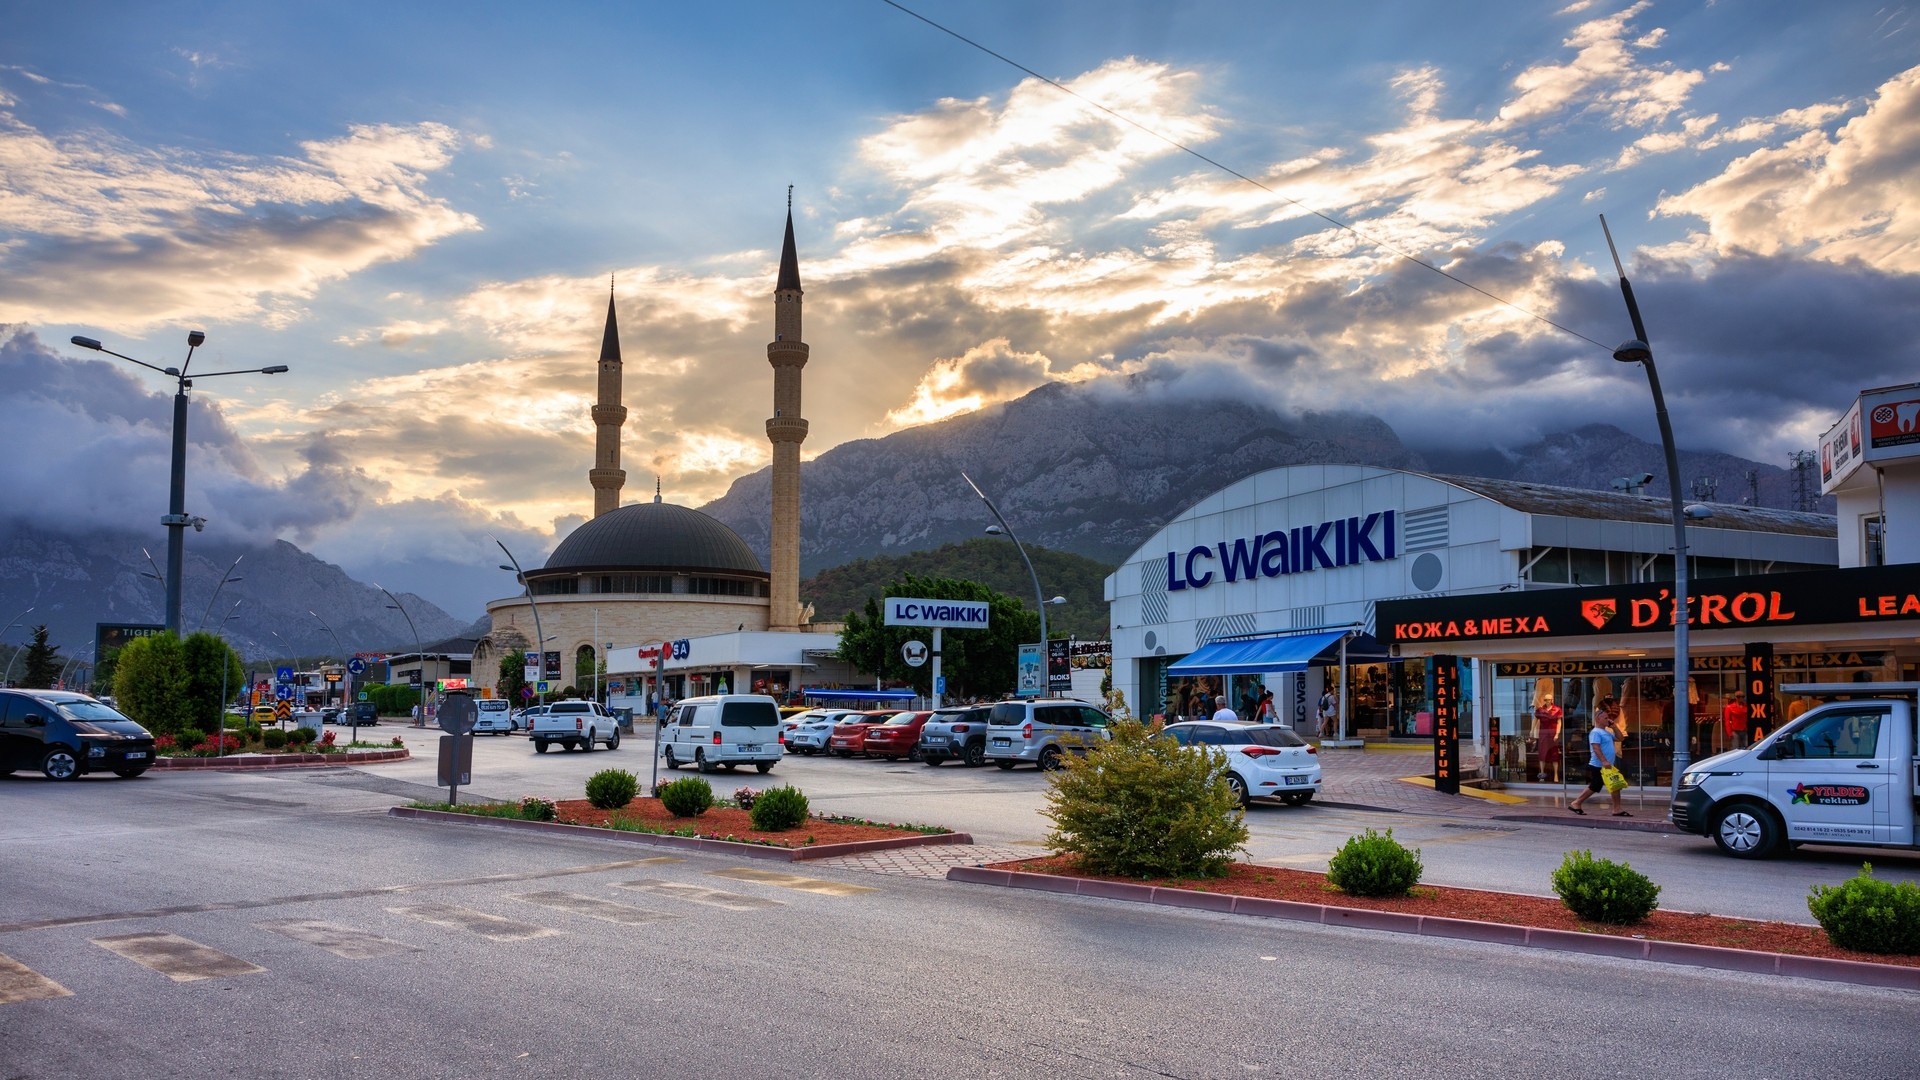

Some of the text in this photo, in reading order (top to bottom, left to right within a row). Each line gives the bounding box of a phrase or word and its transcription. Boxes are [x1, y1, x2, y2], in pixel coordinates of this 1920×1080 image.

[1168, 545, 1213, 591] LC
[896, 604, 919, 620] LC
[1790, 652, 1863, 666] МЕХА
[1516, 662, 1590, 674] D'EROL
[1437, 666, 1448, 736] LEATHER
[1751, 656, 1766, 741] КОЖА
[1297, 705, 1305, 722] LC
[1438, 749, 1448, 778] FUR
[1813, 787, 1864, 797] YILDIZ
[1819, 797, 1858, 805] reklam
